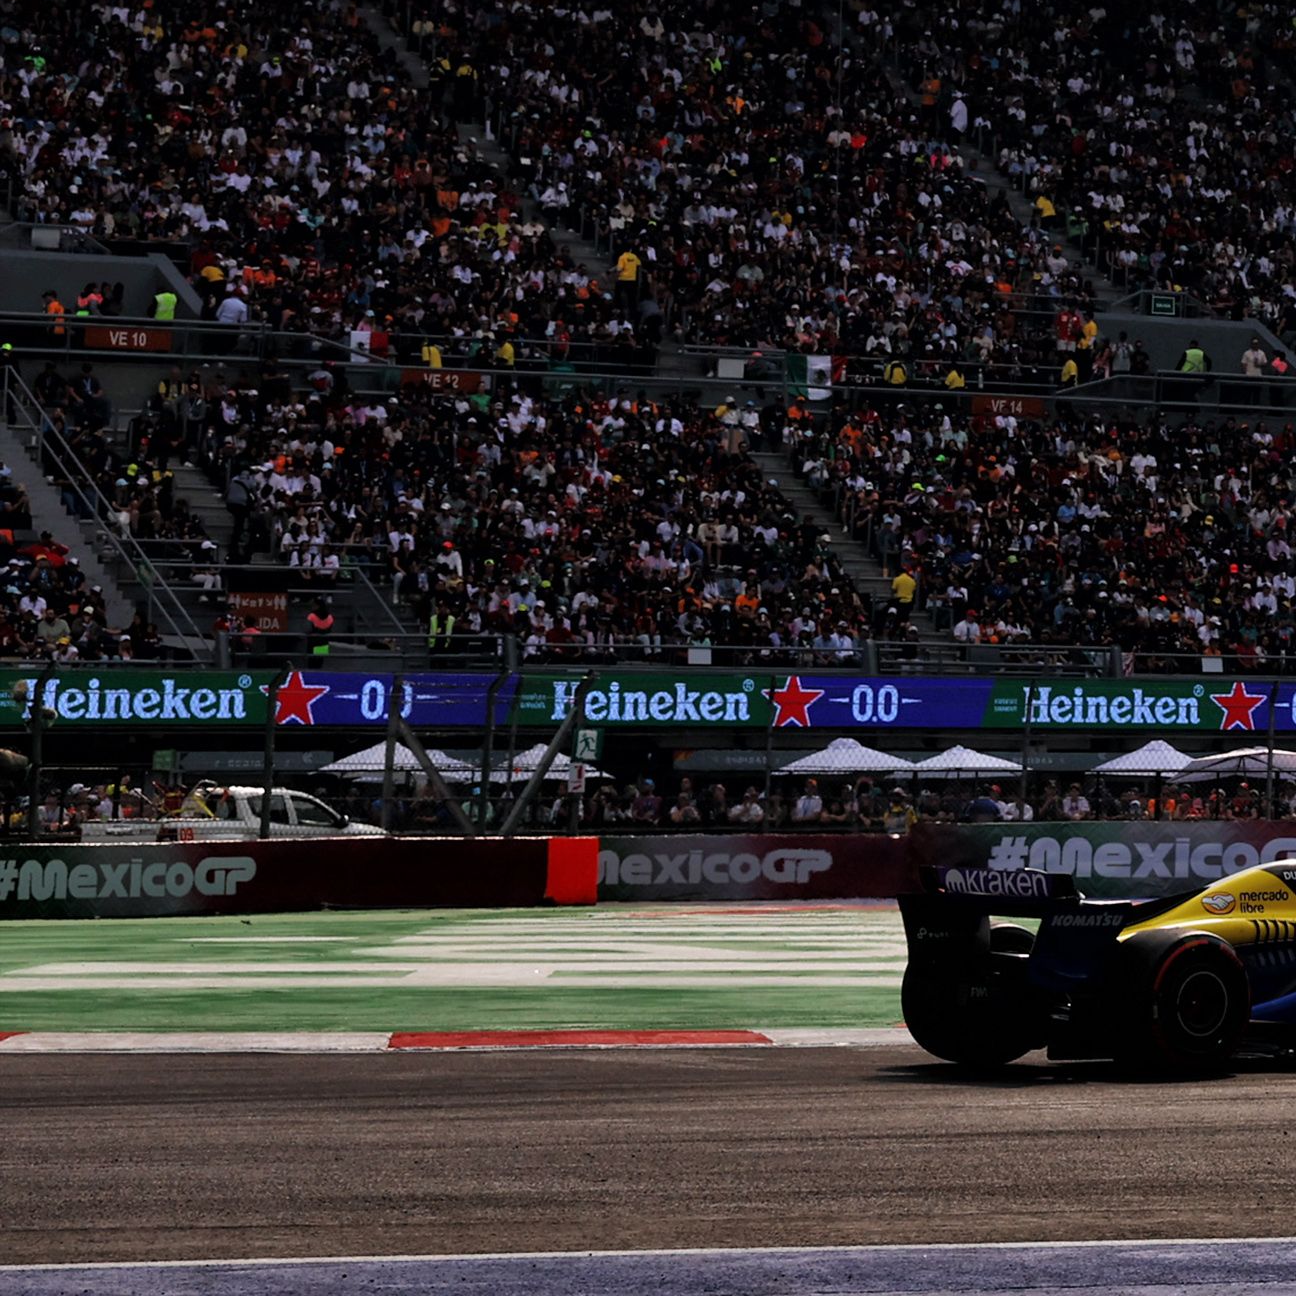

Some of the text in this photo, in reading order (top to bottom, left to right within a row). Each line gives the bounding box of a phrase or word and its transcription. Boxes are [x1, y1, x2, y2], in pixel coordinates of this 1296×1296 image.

[109, 330, 147, 347] VE 10
[423, 373, 441, 388] VE
[1010, 400, 1022, 414] 14
[852, 685, 898, 722] 0.0
[1239, 889, 1289, 902] mercado
[1239, 902, 1265, 914] libre
[1051, 912, 1123, 927] KOMATSU
